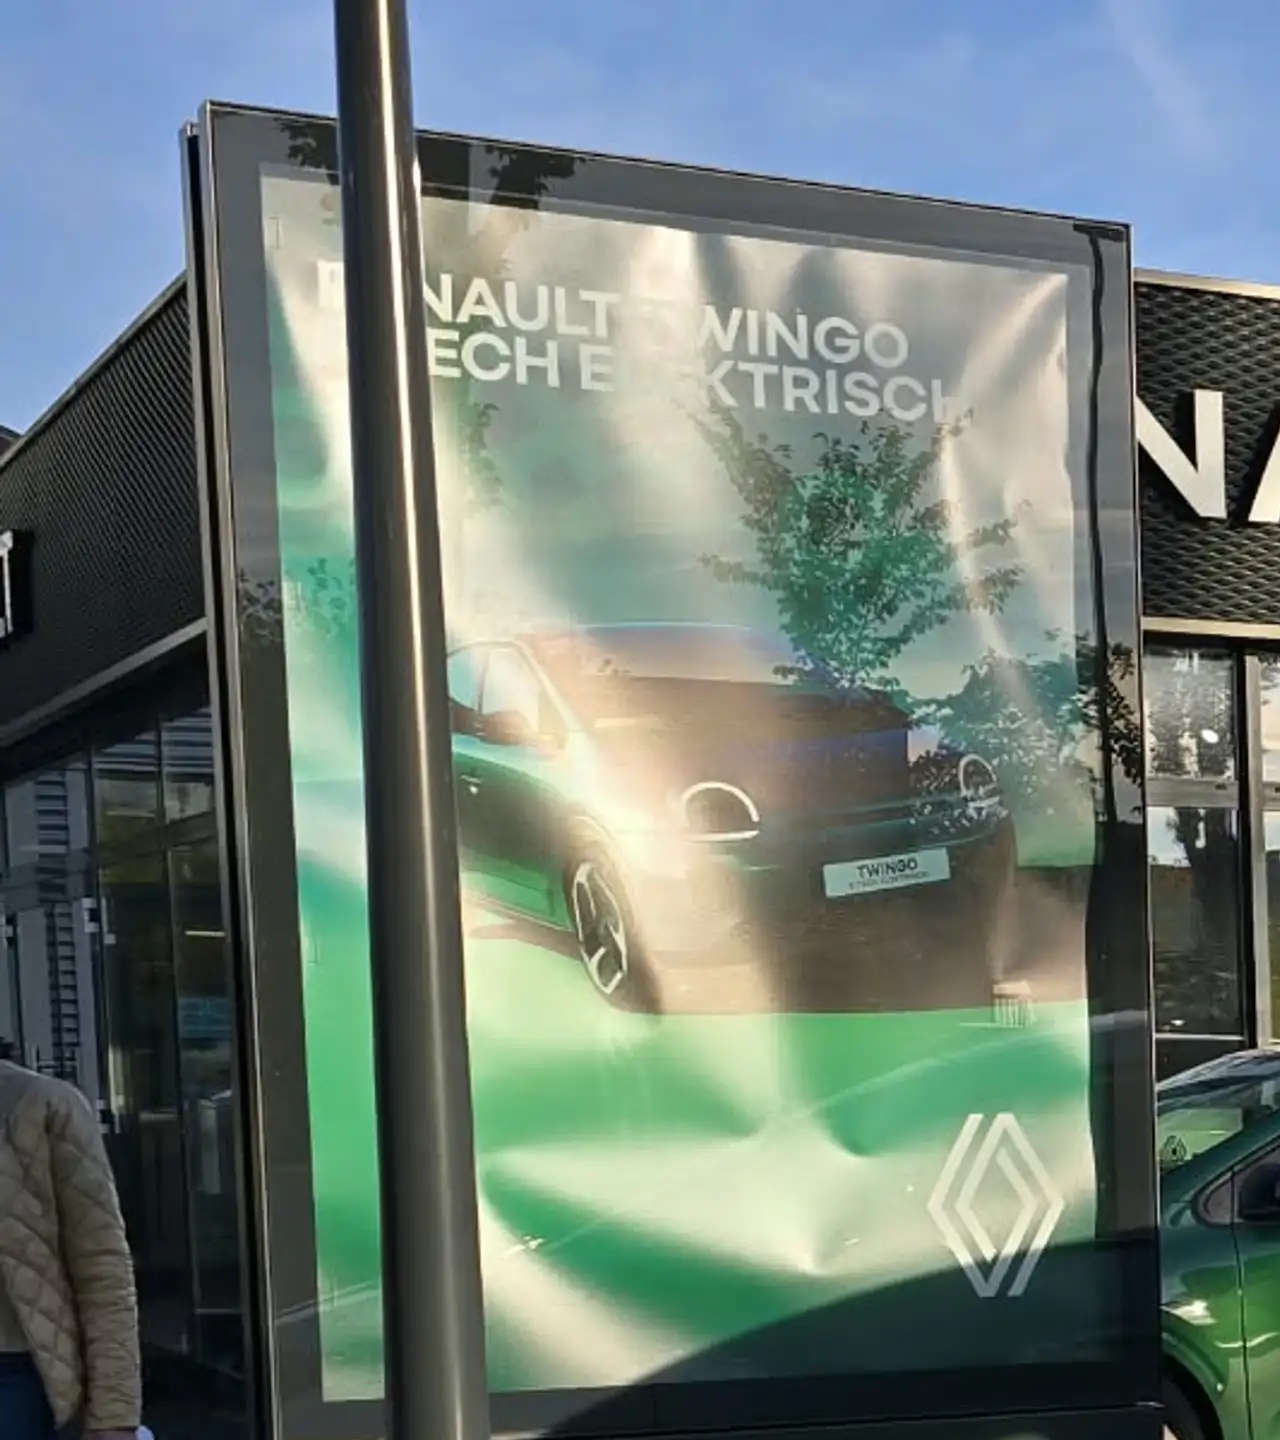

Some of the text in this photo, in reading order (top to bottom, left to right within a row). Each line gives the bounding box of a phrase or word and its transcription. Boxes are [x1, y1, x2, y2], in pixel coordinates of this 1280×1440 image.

[316, 259, 909, 369] RNAULT WINGO
[426, 327, 972, 425] ECH EKTRISCH
[856, 858, 918, 879] TWINGO
